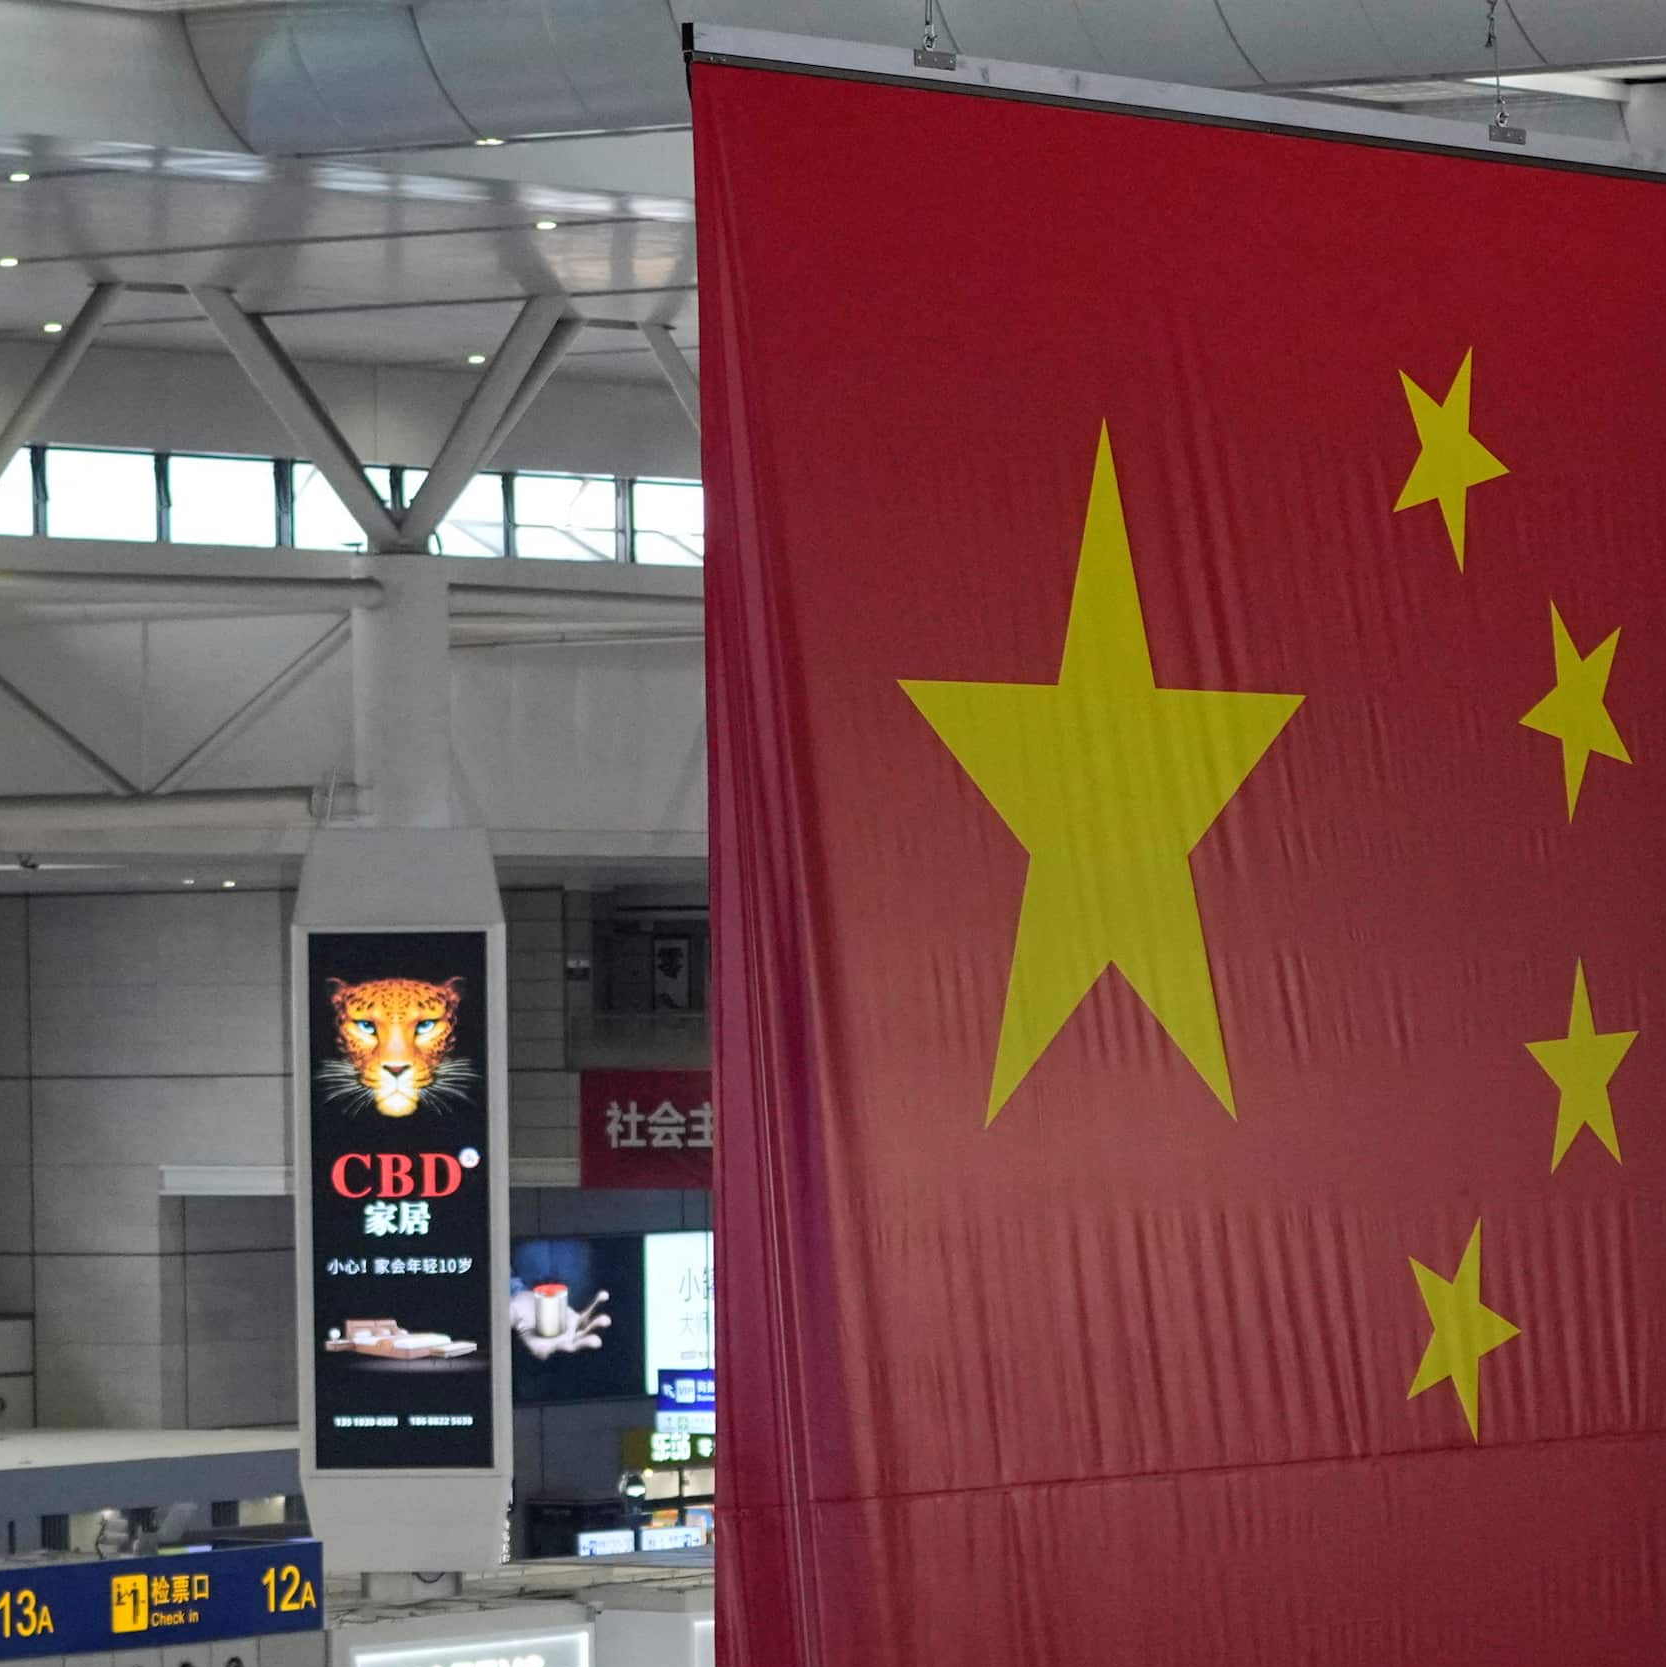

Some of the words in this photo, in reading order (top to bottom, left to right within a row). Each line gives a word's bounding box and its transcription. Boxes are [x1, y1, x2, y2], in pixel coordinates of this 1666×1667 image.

[331, 1153, 462, 1198] CBD
[364, 1202, 431, 1236] 家居
[151, 1574, 211, 1606] 检票口
[262, 1564, 317, 1614] 12A
[151, 1610, 185, 1628] Check
[188, 1609, 200, 1625] in
